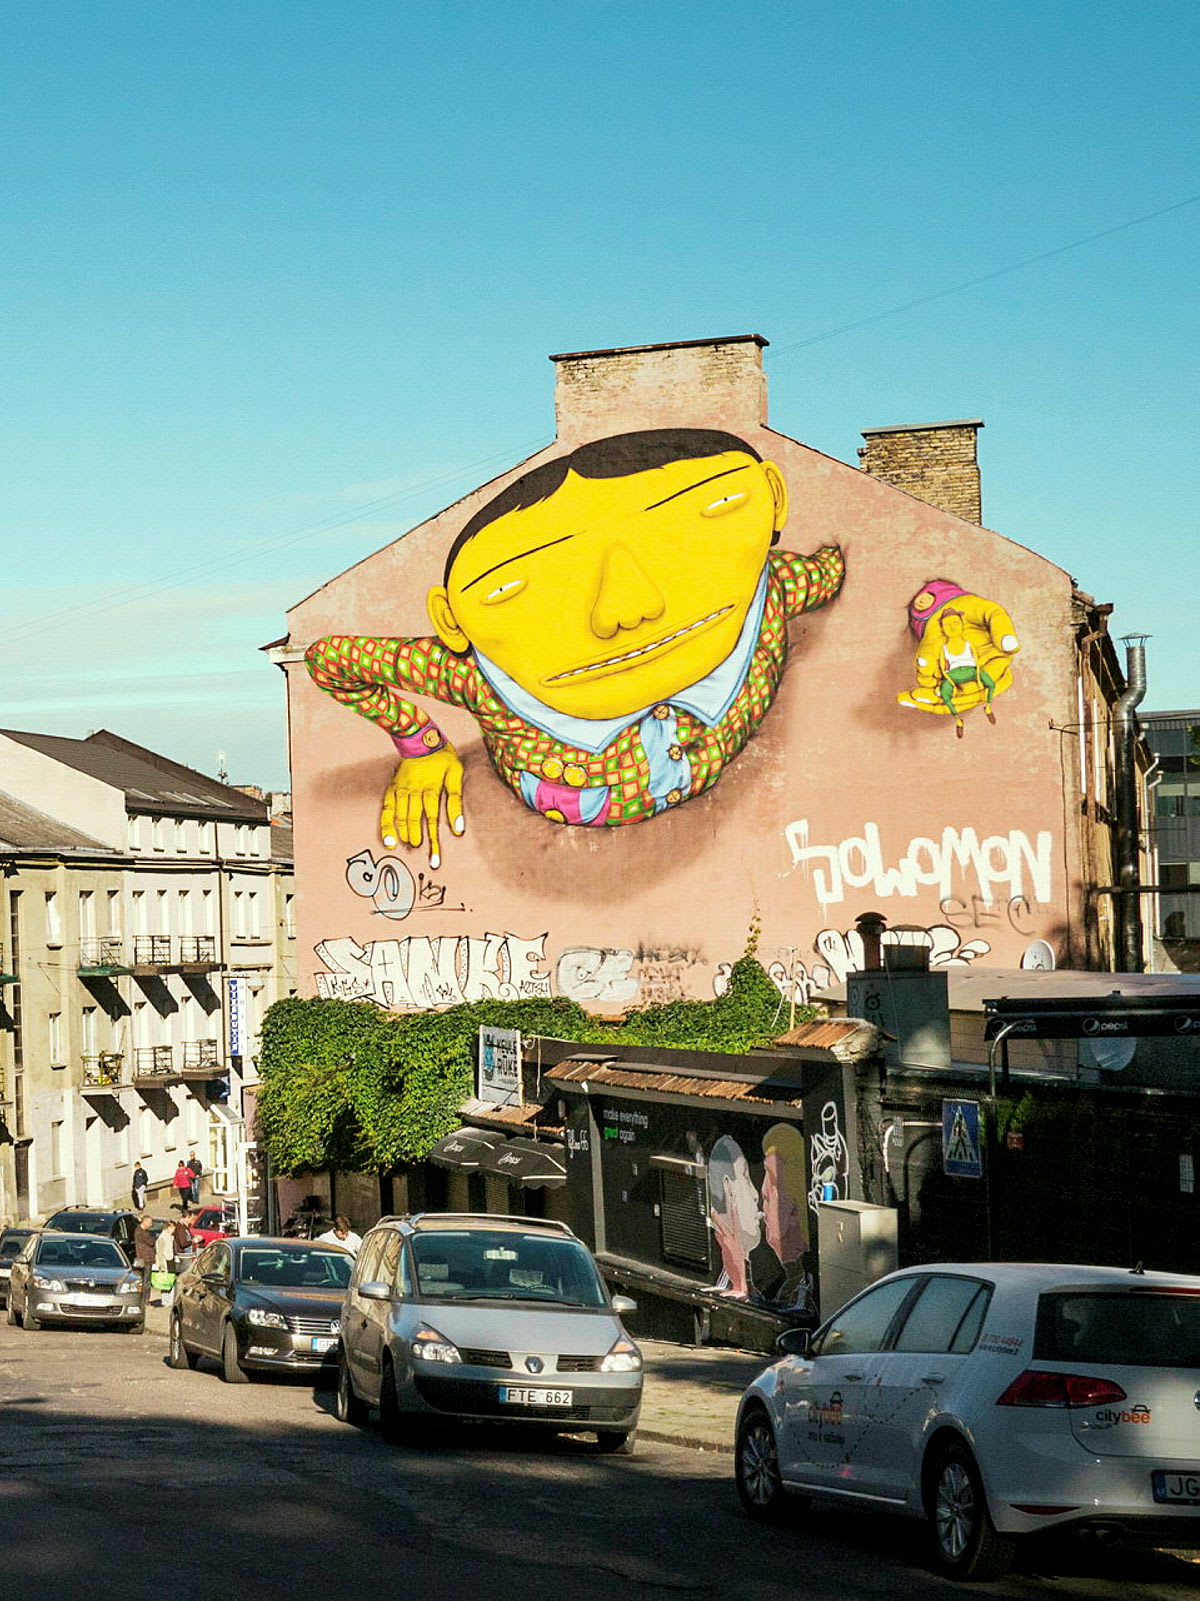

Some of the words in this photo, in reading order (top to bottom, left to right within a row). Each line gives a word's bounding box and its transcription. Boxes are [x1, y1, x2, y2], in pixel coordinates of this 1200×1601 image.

[507, 1389, 537, 1403] FTE
[546, 1391, 570, 1404] 662
[1096, 1409, 1151, 1426] citybee
